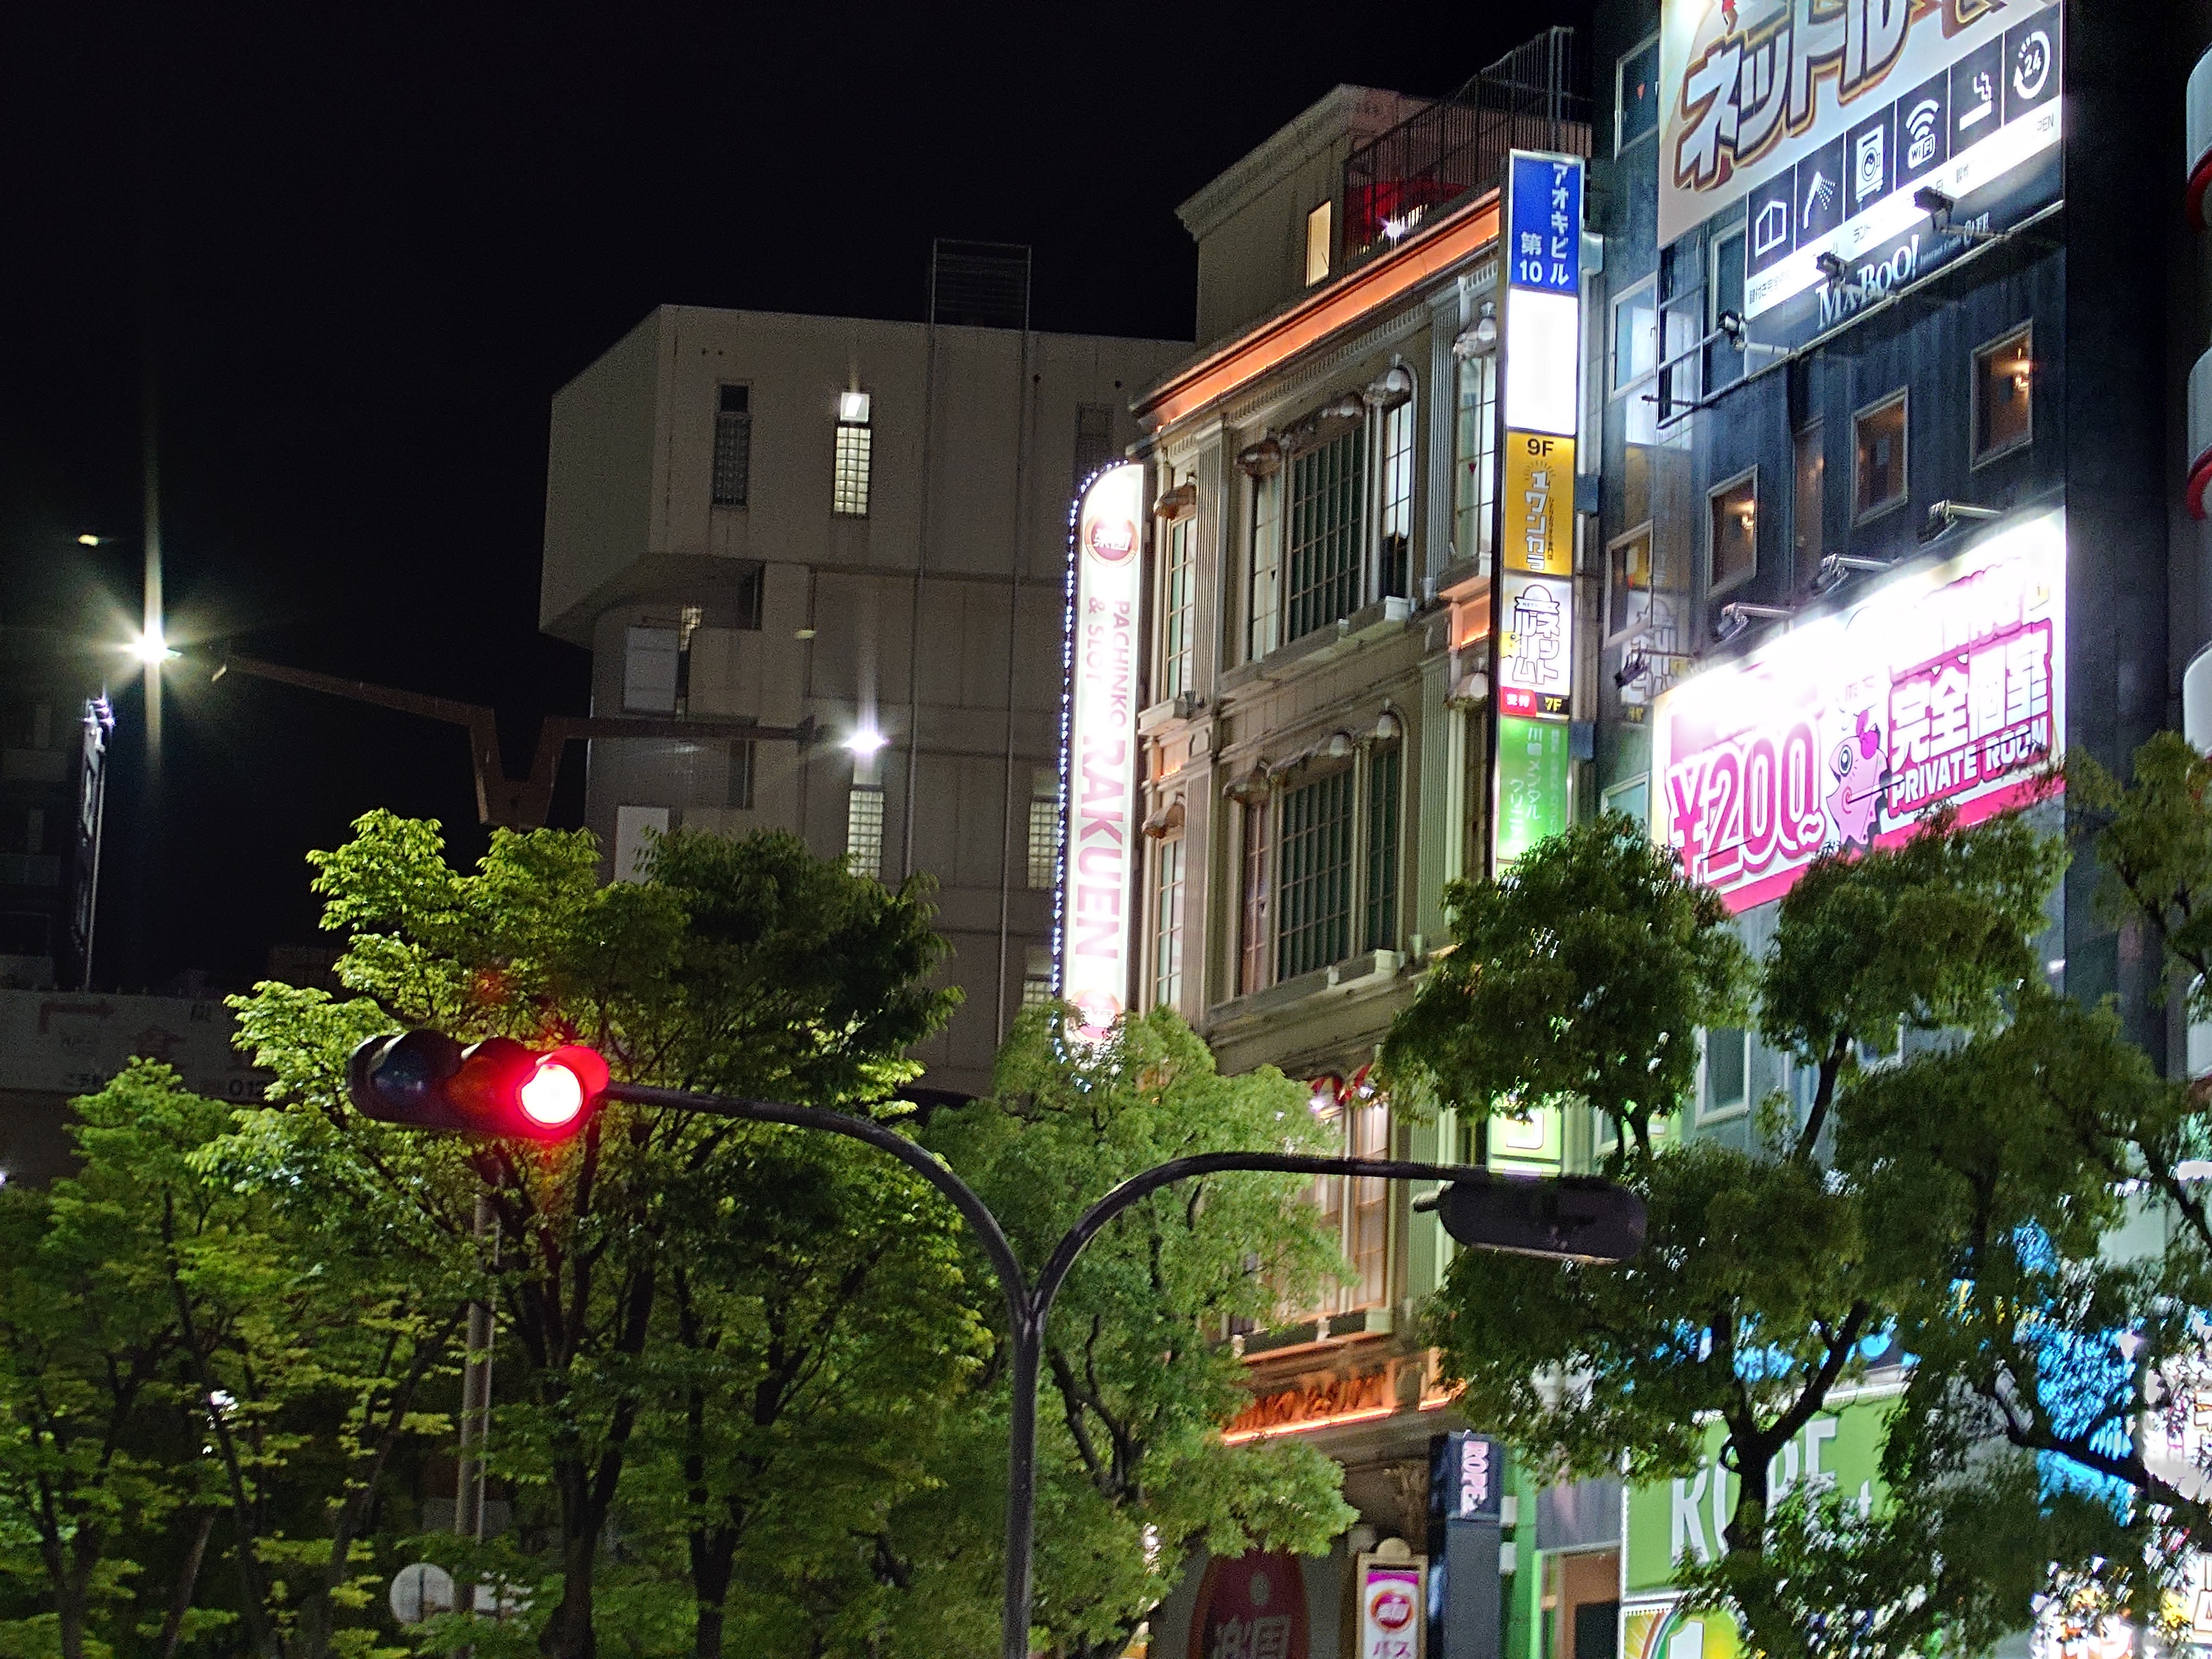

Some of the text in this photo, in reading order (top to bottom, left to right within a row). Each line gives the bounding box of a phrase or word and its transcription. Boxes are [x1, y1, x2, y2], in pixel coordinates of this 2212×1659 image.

[2025, 49, 2041, 78] 24
[1550, 162, 1569, 286] アオキビル
[1527, 439, 1554, 458] 9F
[1086, 624, 1104, 681] SLOT
[1109, 601, 1130, 729] PACHINKO
[1545, 697, 1562, 712] 7F
[1891, 629, 2048, 773] 完全個室
[1890, 717, 2048, 808] PRIVATE ROOM
[1075, 735, 1126, 959] RAKUEN
